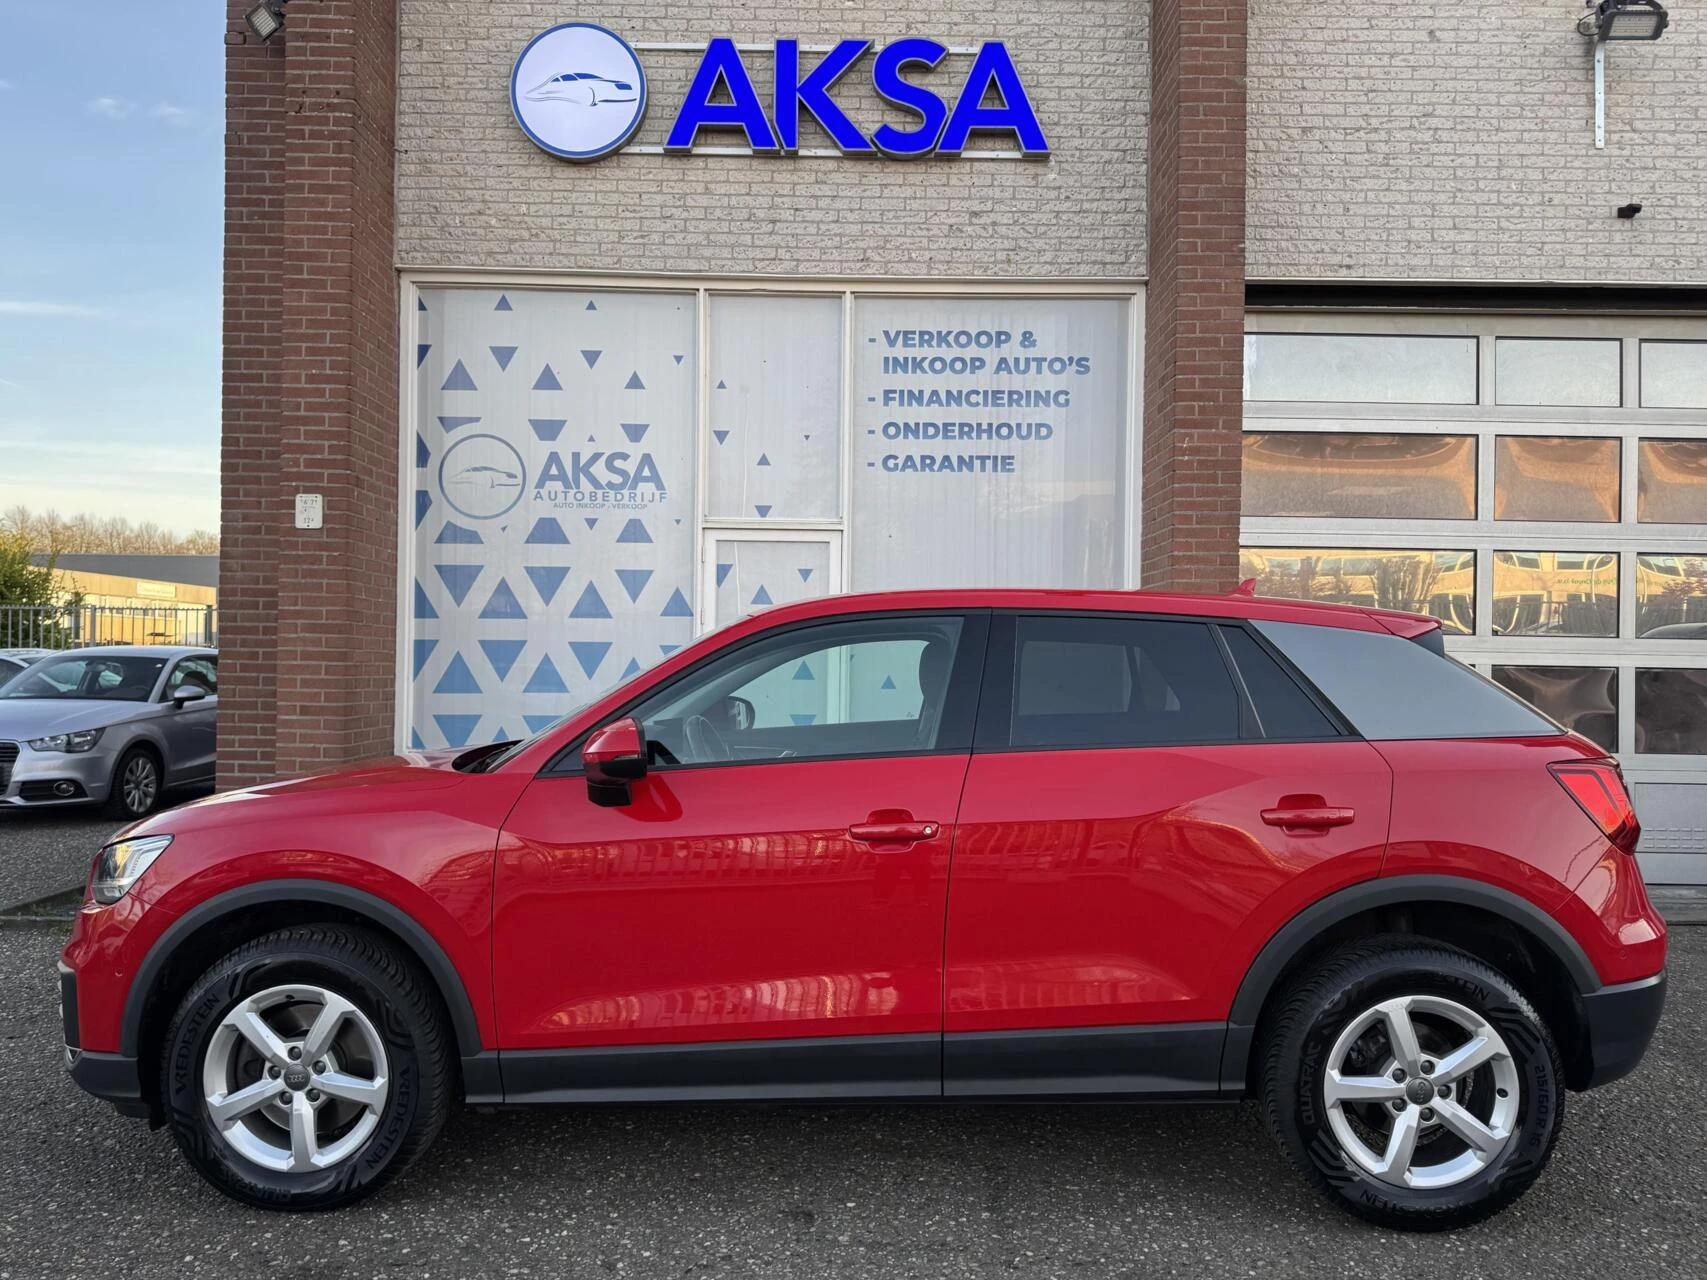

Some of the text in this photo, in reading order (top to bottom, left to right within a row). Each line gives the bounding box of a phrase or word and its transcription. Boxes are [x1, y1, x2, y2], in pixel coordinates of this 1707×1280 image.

[663, 36, 1052, 159] AKSA
[882, 330, 1012, 349] VERKOOP
[1019, 330, 1038, 349] &
[883, 356, 1091, 376] INKOOP AUTO'S
[882, 389, 1071, 408] FINANCIERING
[882, 421, 1054, 441] ONDERHOUD
[534, 451, 666, 491] AKSA
[881, 454, 1016, 473] GARANTIE
[534, 490, 668, 503] AUTOBEDRIJF
[575, 502, 606, 510] INKOOP
[175, 993, 220, 1095] VREDESTEIN
[1534, 1064, 1549, 1115] 215/60
[366, 1066, 410, 1169] VREDESTEIN
